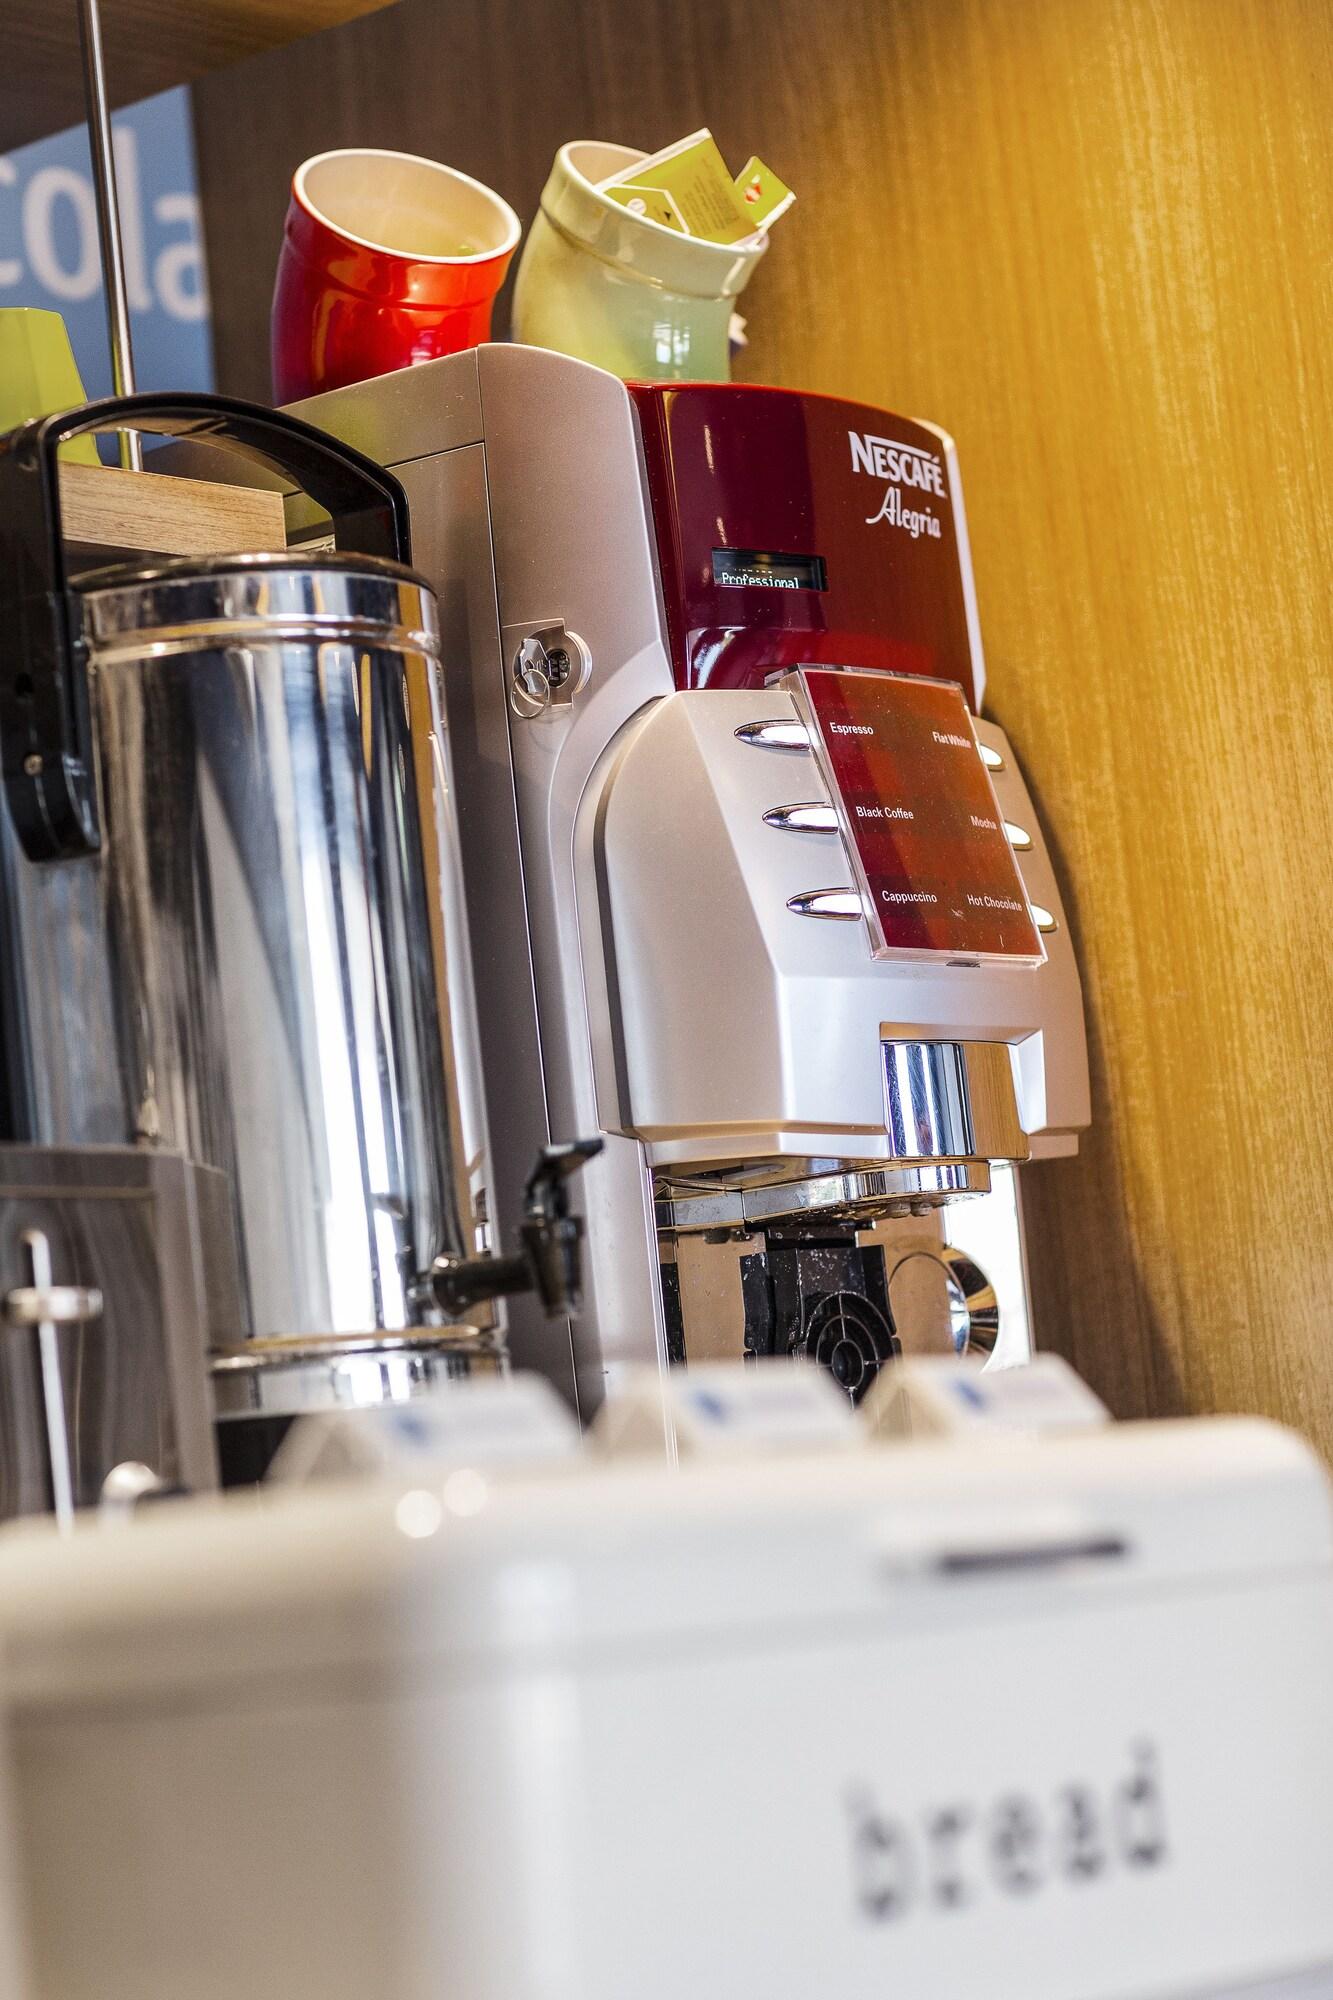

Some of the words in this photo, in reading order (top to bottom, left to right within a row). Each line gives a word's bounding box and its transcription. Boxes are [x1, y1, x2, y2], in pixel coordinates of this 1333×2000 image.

[0, 126, 210, 322] ola
[847, 431, 948, 498] NESCAFÉ
[865, 486, 942, 539] Alegria
[721, 572, 800, 589] Professional
[829, 722, 874, 736] Espresso
[932, 731, 949, 745] Flat
[947, 734, 972, 749] White
[855, 806, 883, 819] Black
[884, 807, 914, 820] Coffee
[970, 815, 997, 830] Mocha
[881, 890, 938, 904] Cappuccino
[966, 894, 982, 906] Hot
[984, 895, 1023, 912] Chocolate
[845, 1735, 1172, 1926] bread
